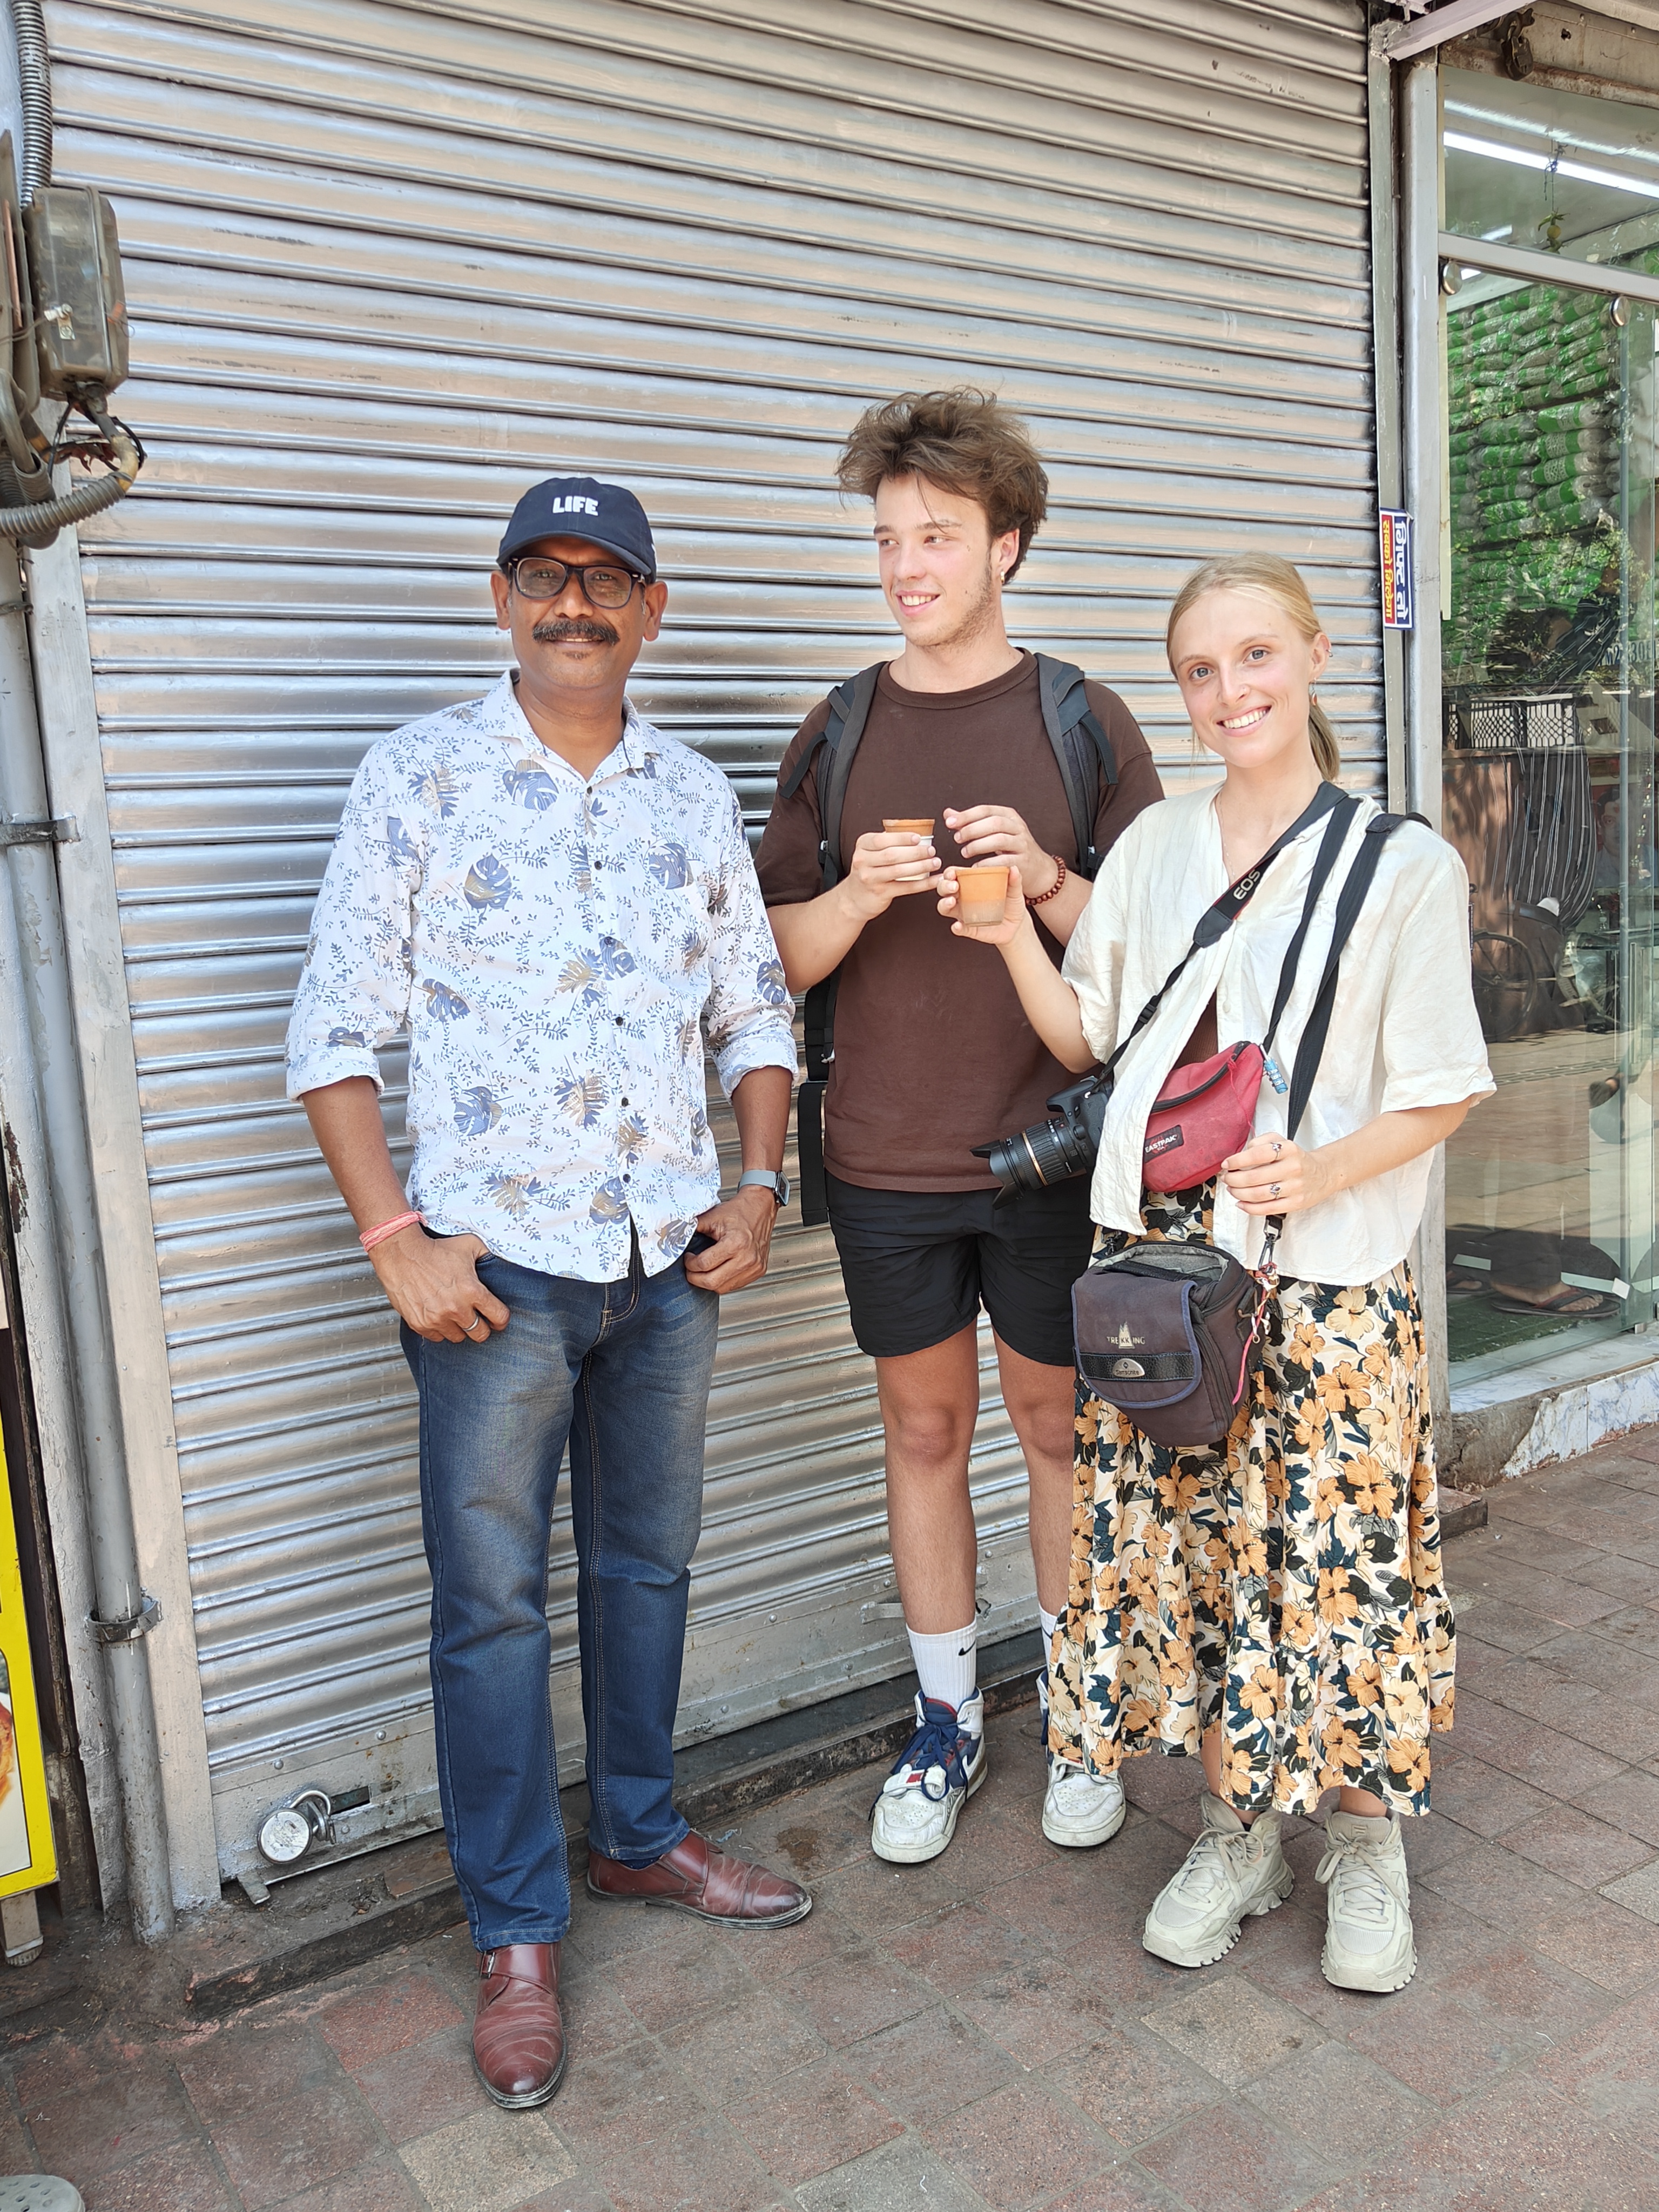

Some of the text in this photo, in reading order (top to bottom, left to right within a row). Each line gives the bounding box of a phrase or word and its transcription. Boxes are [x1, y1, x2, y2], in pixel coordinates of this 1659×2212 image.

[553, 495, 598, 516] LIFE
[1395, 521, 1408, 620] गिफ्ट तो
[1385, 568, 1394, 619] मिलेगा
[1233, 869, 1260, 900] EOS
[1145, 1134, 1177, 1153] EASTPAK
[1107, 1336, 1145, 1344] TREKKING
